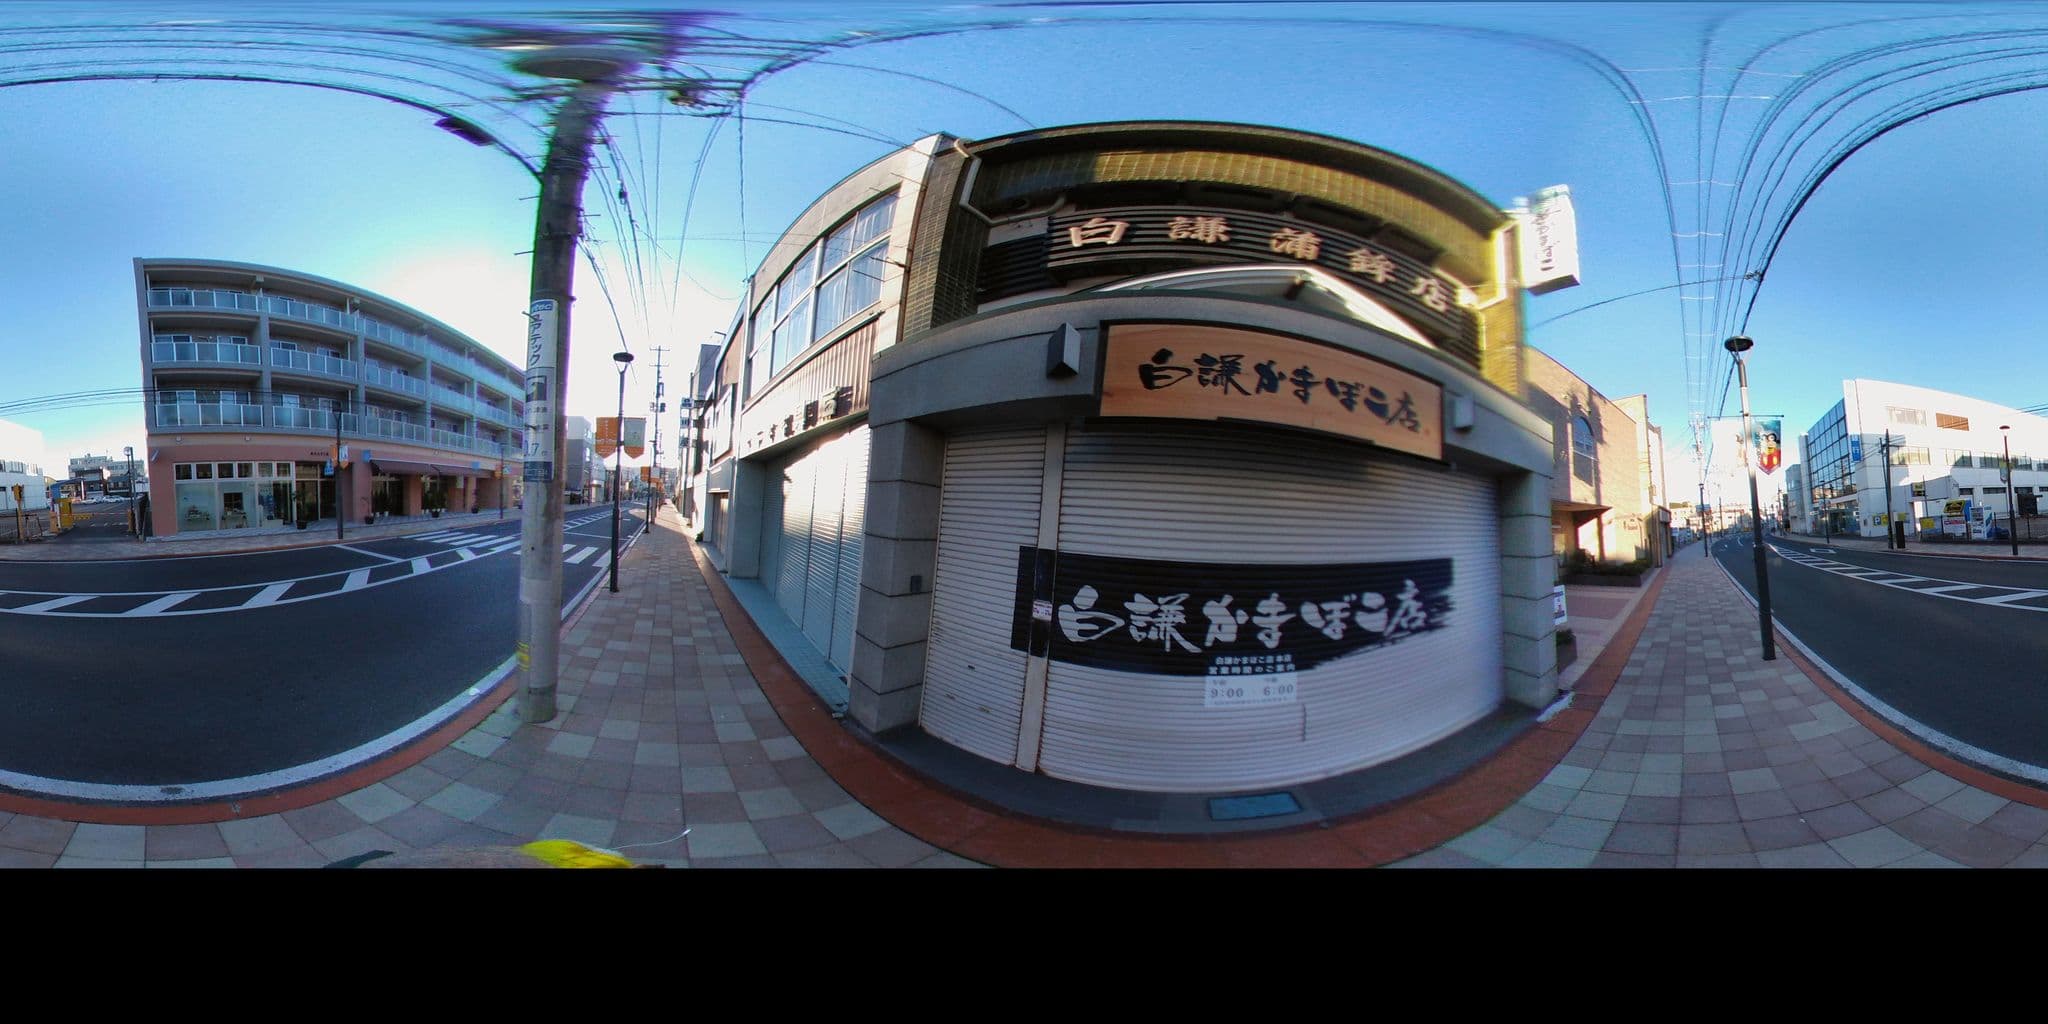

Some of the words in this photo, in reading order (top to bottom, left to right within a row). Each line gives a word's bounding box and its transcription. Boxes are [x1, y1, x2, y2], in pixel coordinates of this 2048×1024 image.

[1069, 216, 1451, 313] 白謙蒲鉾店
[1138, 347, 1422, 433] 白謙かまぼこ店
[1058, 578, 1428, 653] 白謙かまぼこ店
[1210, 687, 1244, 698] 9:00
